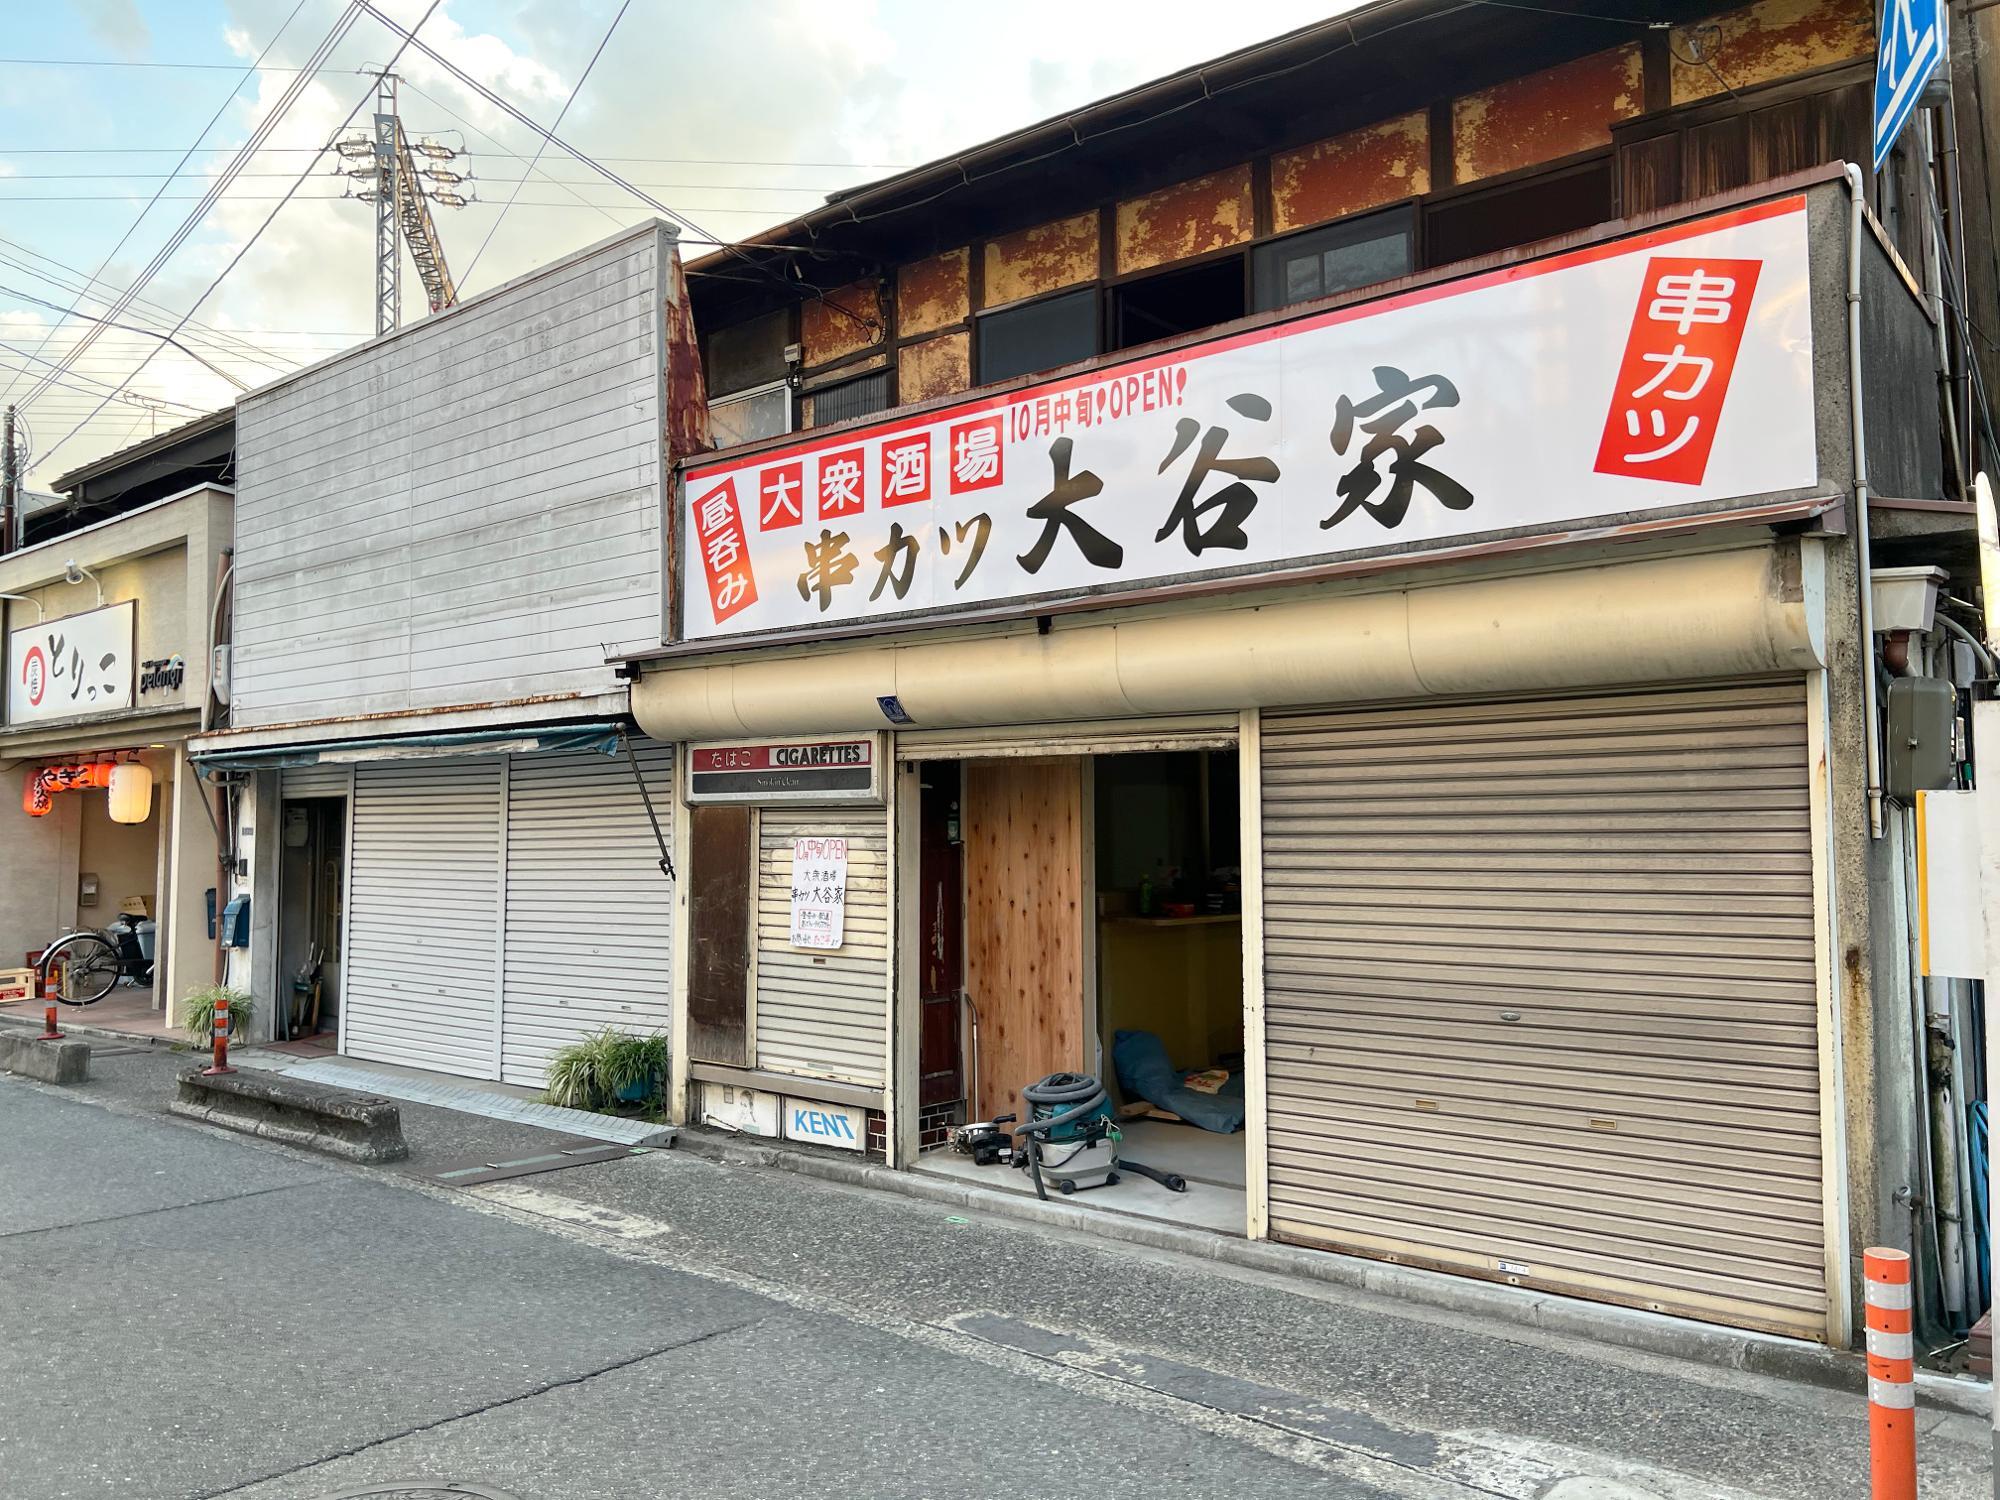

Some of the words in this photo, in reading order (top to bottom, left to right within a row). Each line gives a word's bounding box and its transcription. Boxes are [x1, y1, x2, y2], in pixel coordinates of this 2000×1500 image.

[1622, 268, 1736, 463] 串カツ
[762, 428, 1001, 527] 大衆酒場
[796, 512, 993, 612] 串カツ
[1016, 365, 1475, 577] 大谷家
[701, 489, 749, 611] 昼呑み
[48, 633, 117, 702] とりっこ
[776, 744, 861, 765] CIGARETTES
[811, 885, 845, 905] 大谷家
[795, 1109, 855, 1140] KENT
